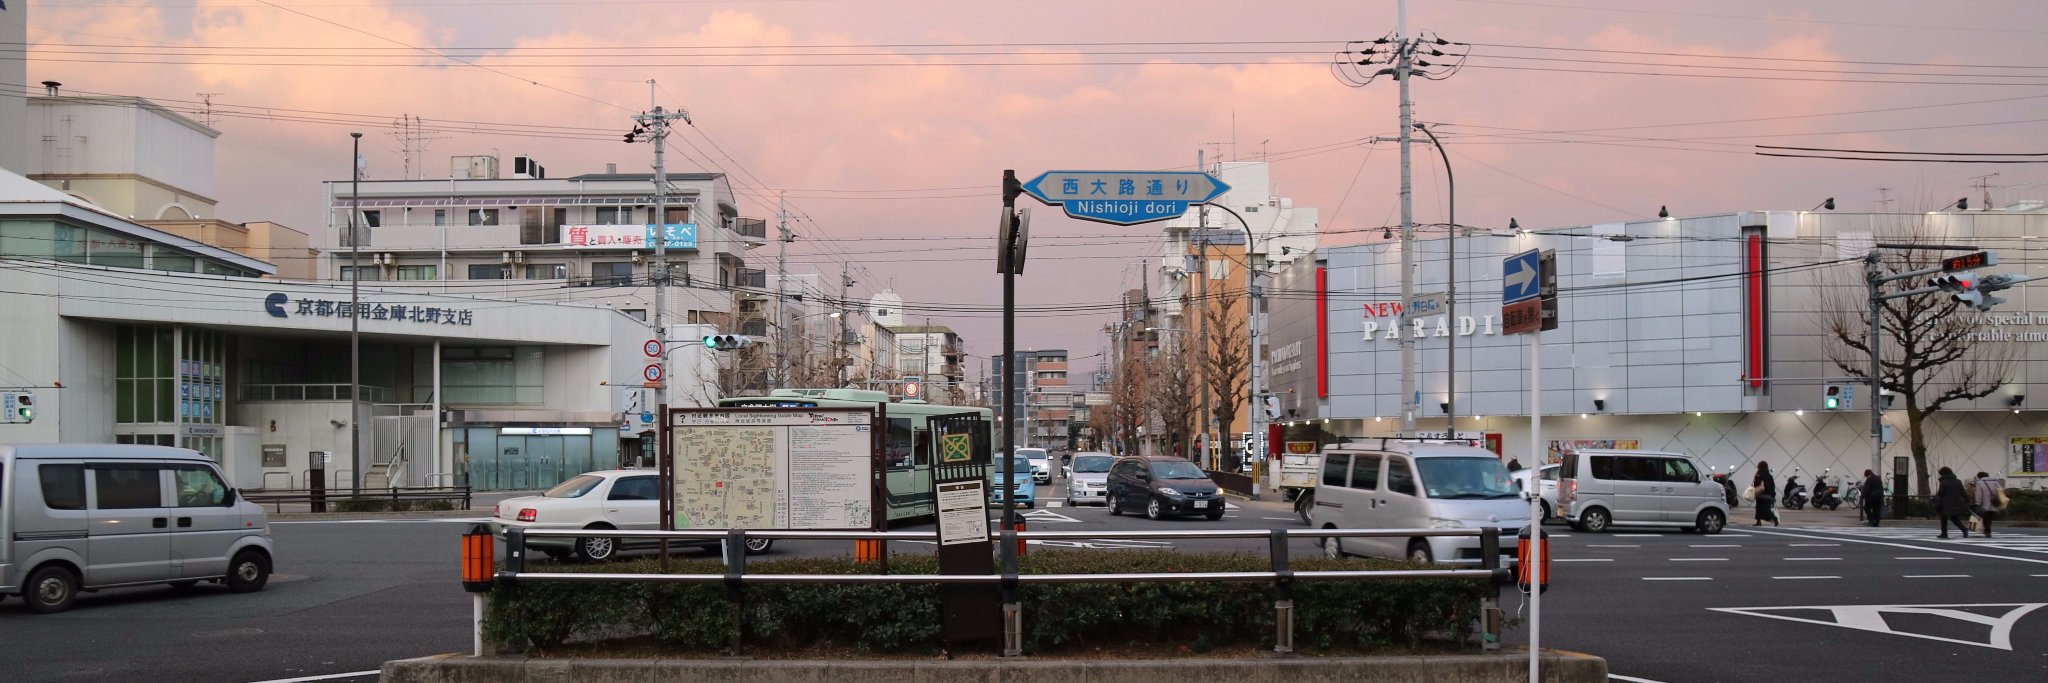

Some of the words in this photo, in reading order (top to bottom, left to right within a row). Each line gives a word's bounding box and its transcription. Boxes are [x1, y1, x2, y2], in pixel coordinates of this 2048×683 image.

[1062, 178, 1189, 196] 西大路通り
[1078, 201, 1139, 216] Nishioji
[1146, 202, 1176, 214] dori
[295, 298, 473, 326] 京都信用金庫北野支店
[1363, 301, 1404, 318] NEW
[1958, 313, 1983, 327] you
[1987, 311, 2033, 327] special
[1362, 314, 1498, 341] PARADI
[2016, 330, 2048, 342] atmo
[647, 344, 658, 353] 50
[907, 385, 916, 393] 50
